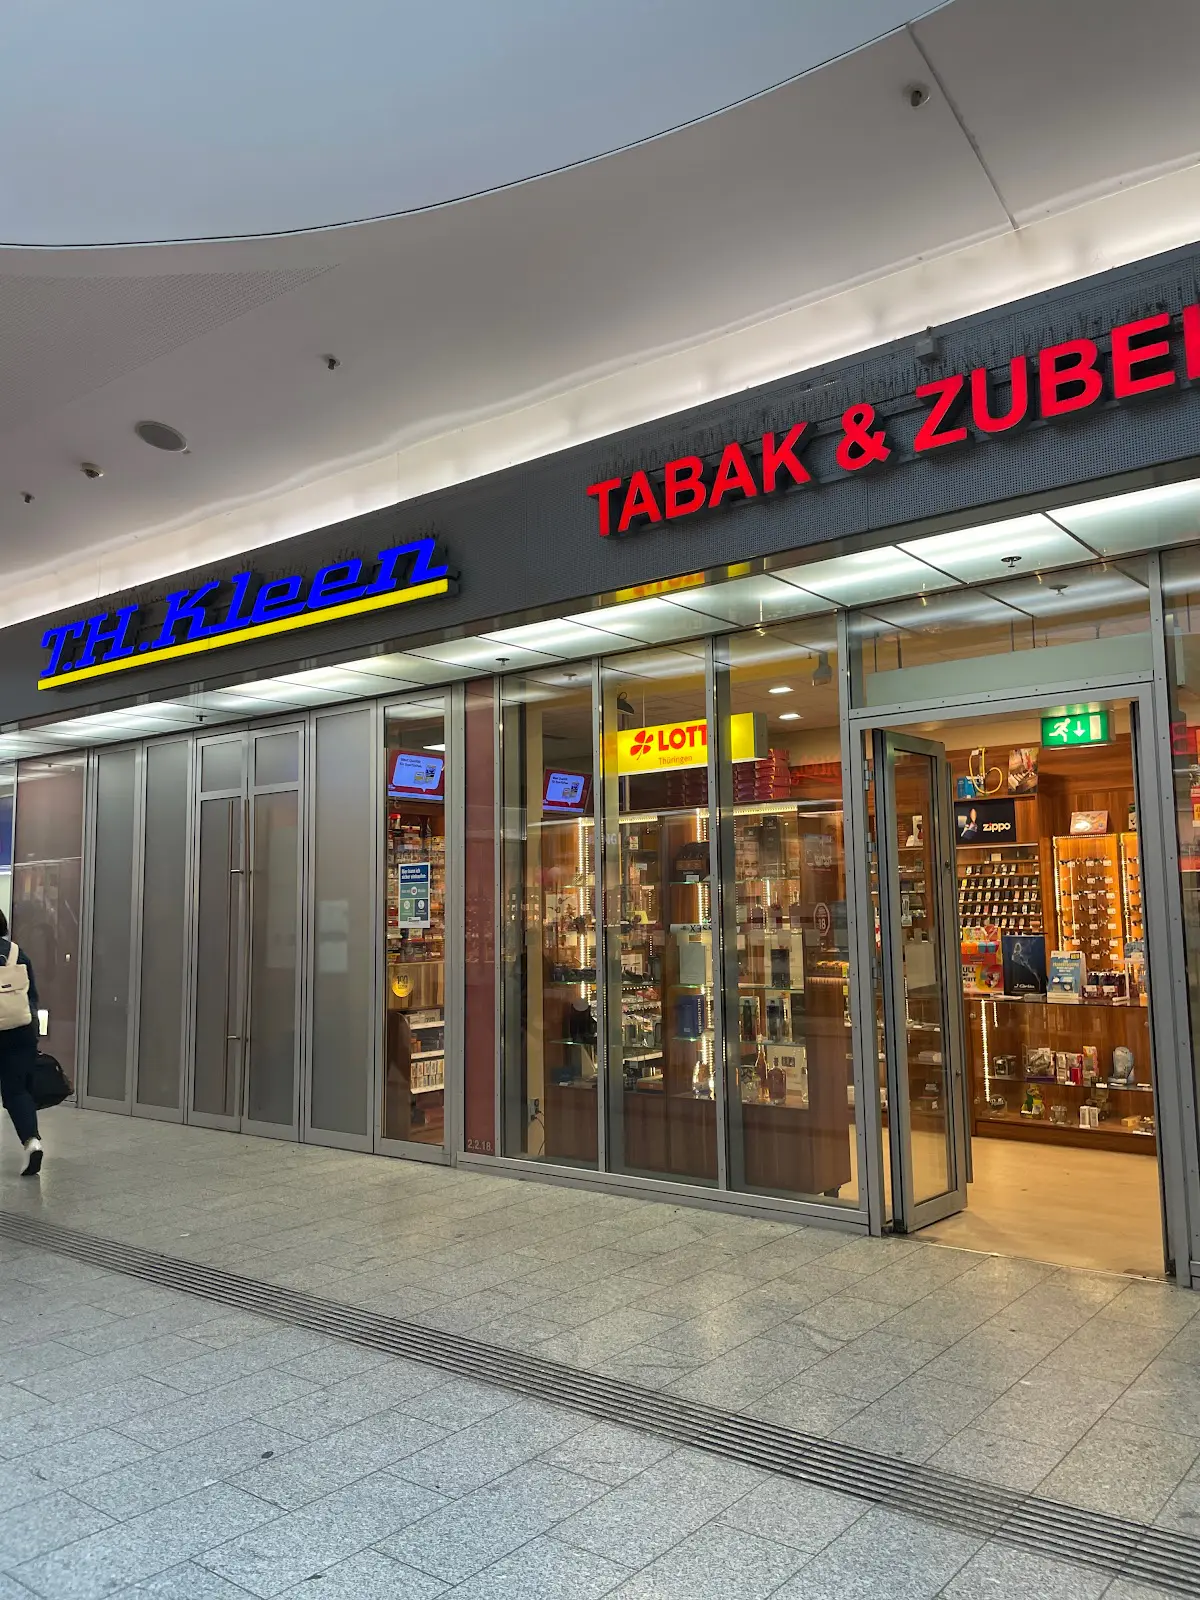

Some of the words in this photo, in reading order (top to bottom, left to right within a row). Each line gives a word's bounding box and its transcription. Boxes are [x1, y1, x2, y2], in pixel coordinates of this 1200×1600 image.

[587, 424, 810, 534] TABAK
[836, 403, 890, 470] &
[151, 538, 448, 648] Kleen
[658, 755, 693, 765] Thüringen
[983, 822, 1011, 833] zippo
